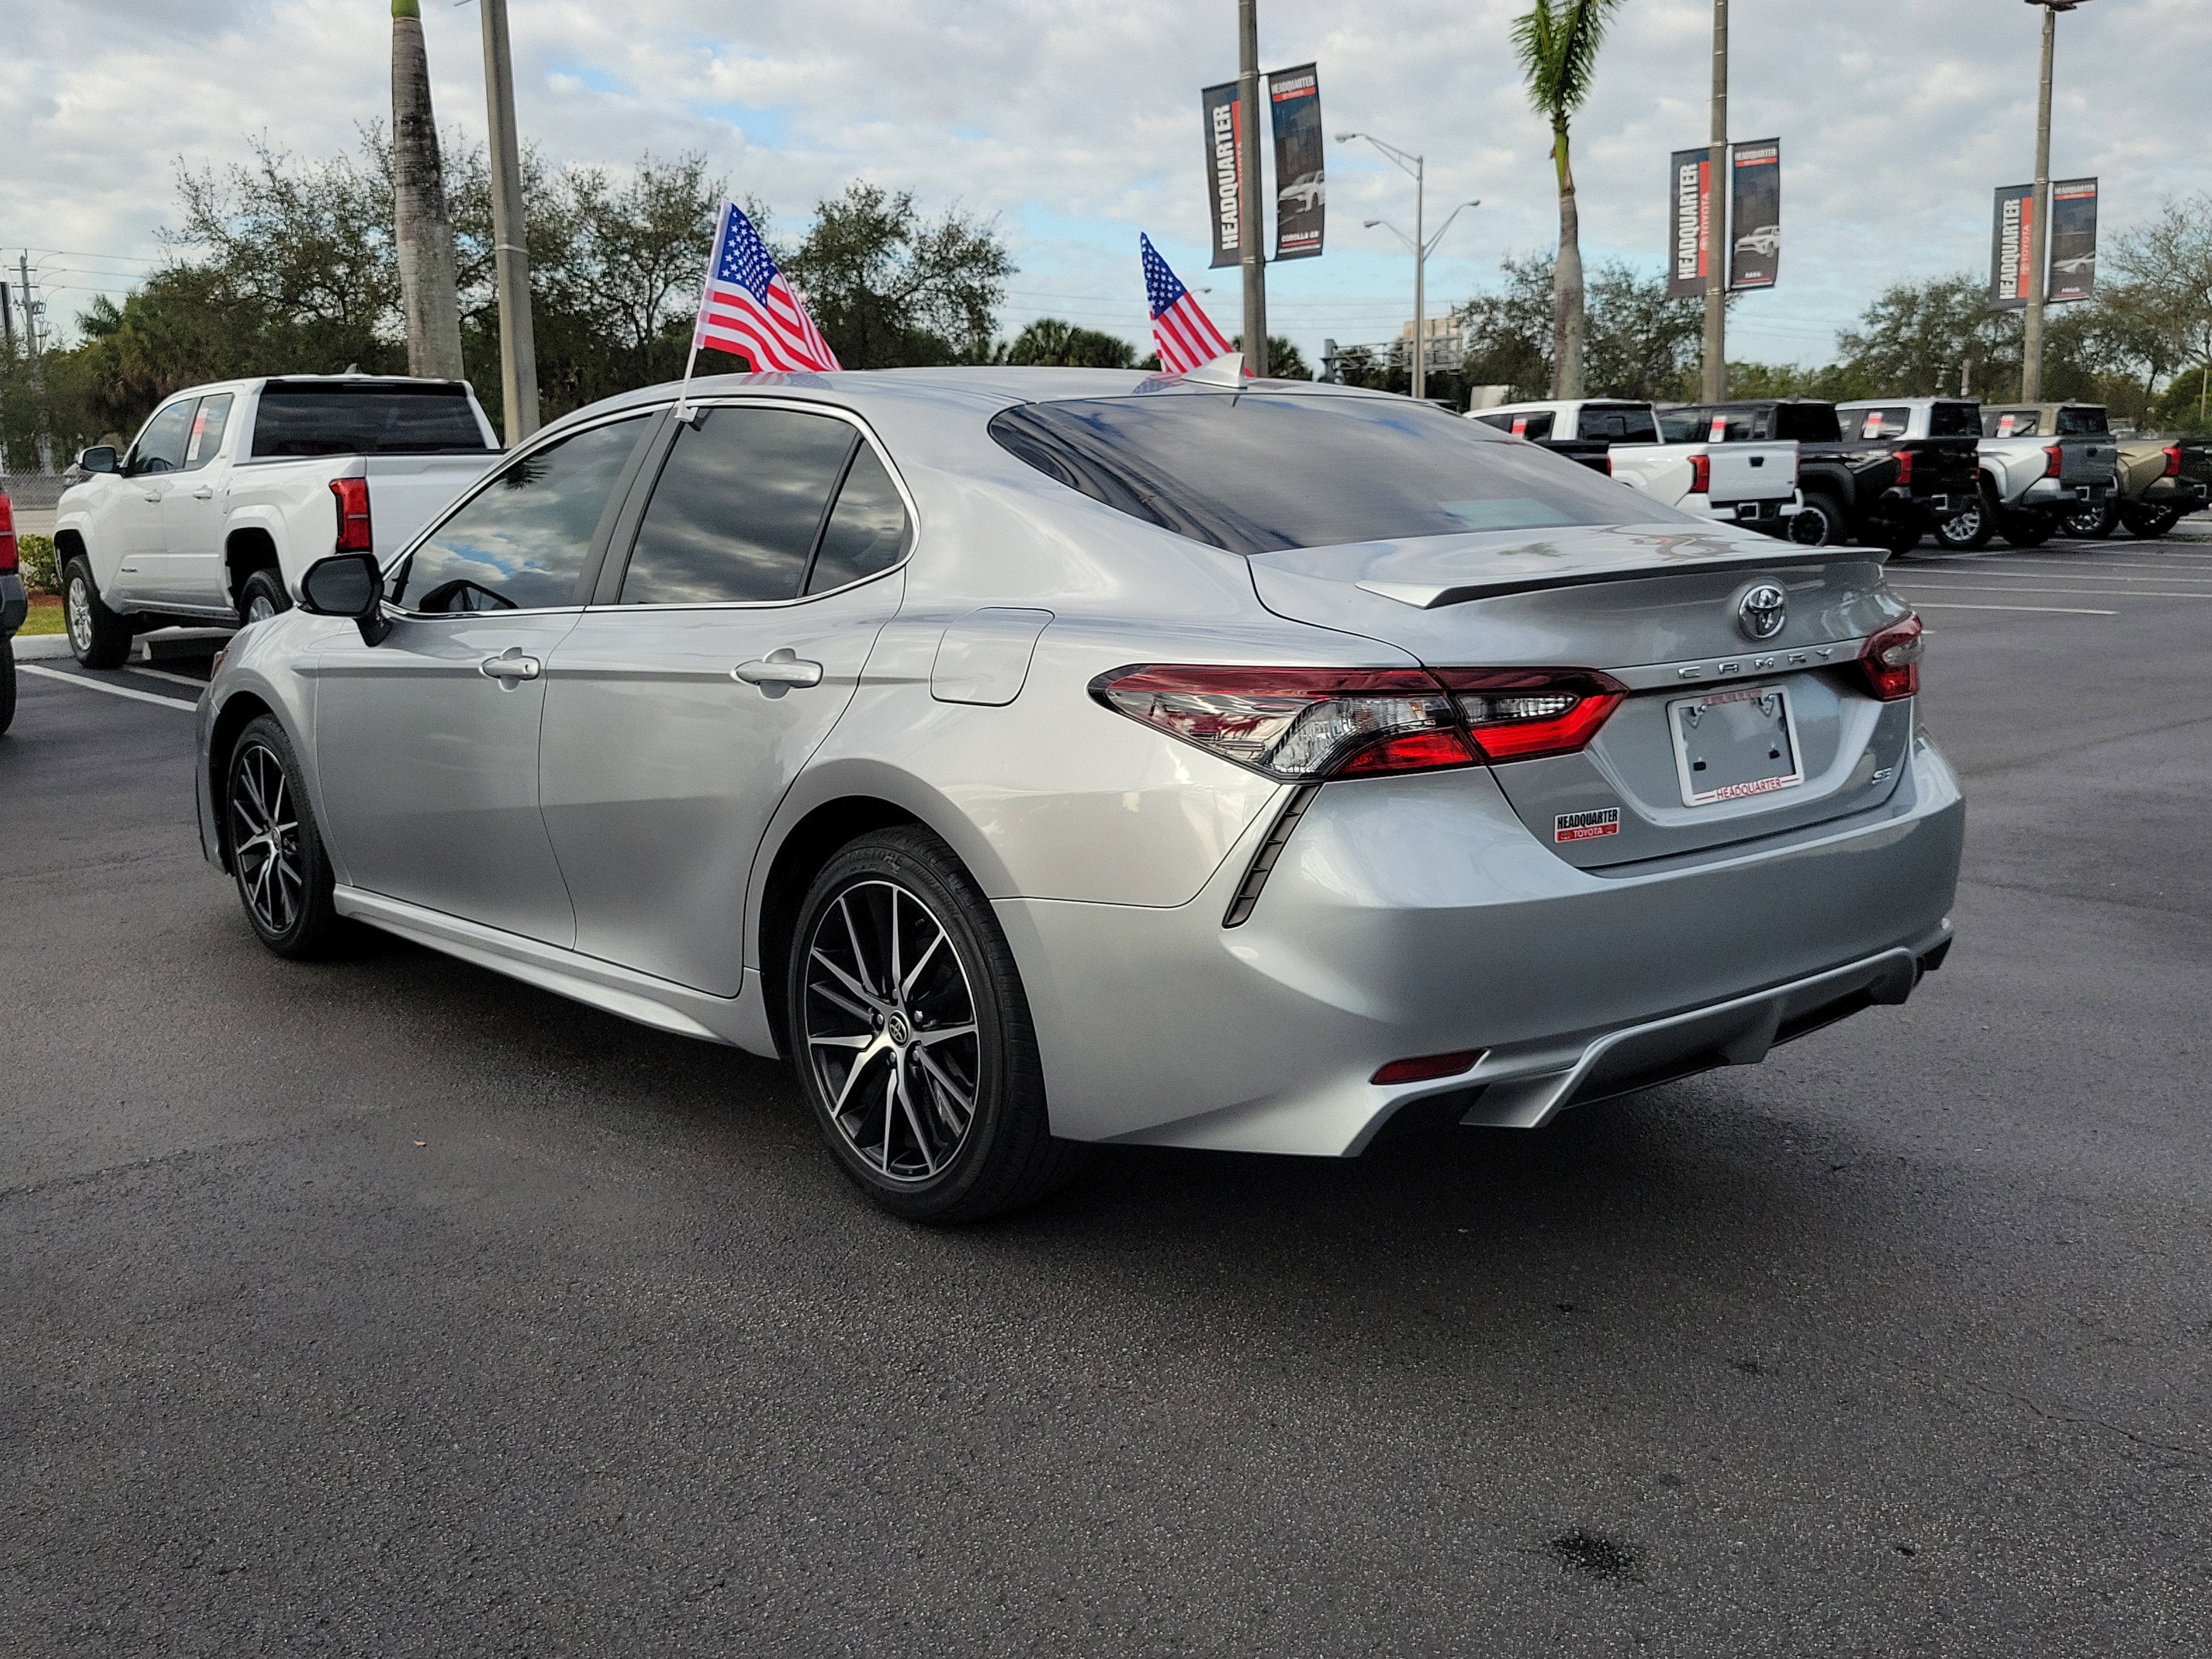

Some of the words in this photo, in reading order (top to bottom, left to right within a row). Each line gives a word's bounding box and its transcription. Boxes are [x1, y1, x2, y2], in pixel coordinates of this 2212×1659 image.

[1212, 103, 1239, 250] HEADQUARTER
[1678, 163, 1699, 280] HEADQUARTER
[1999, 199, 2021, 300] HEADQUARTER
[1678, 648, 1833, 679] CAMRY
[1716, 777, 1782, 800] HEADQUARTER
[1872, 768, 1892, 785] SE
[1557, 809, 1618, 829] HEADQUARTER
[1573, 827, 1602, 838] TOYOTA
